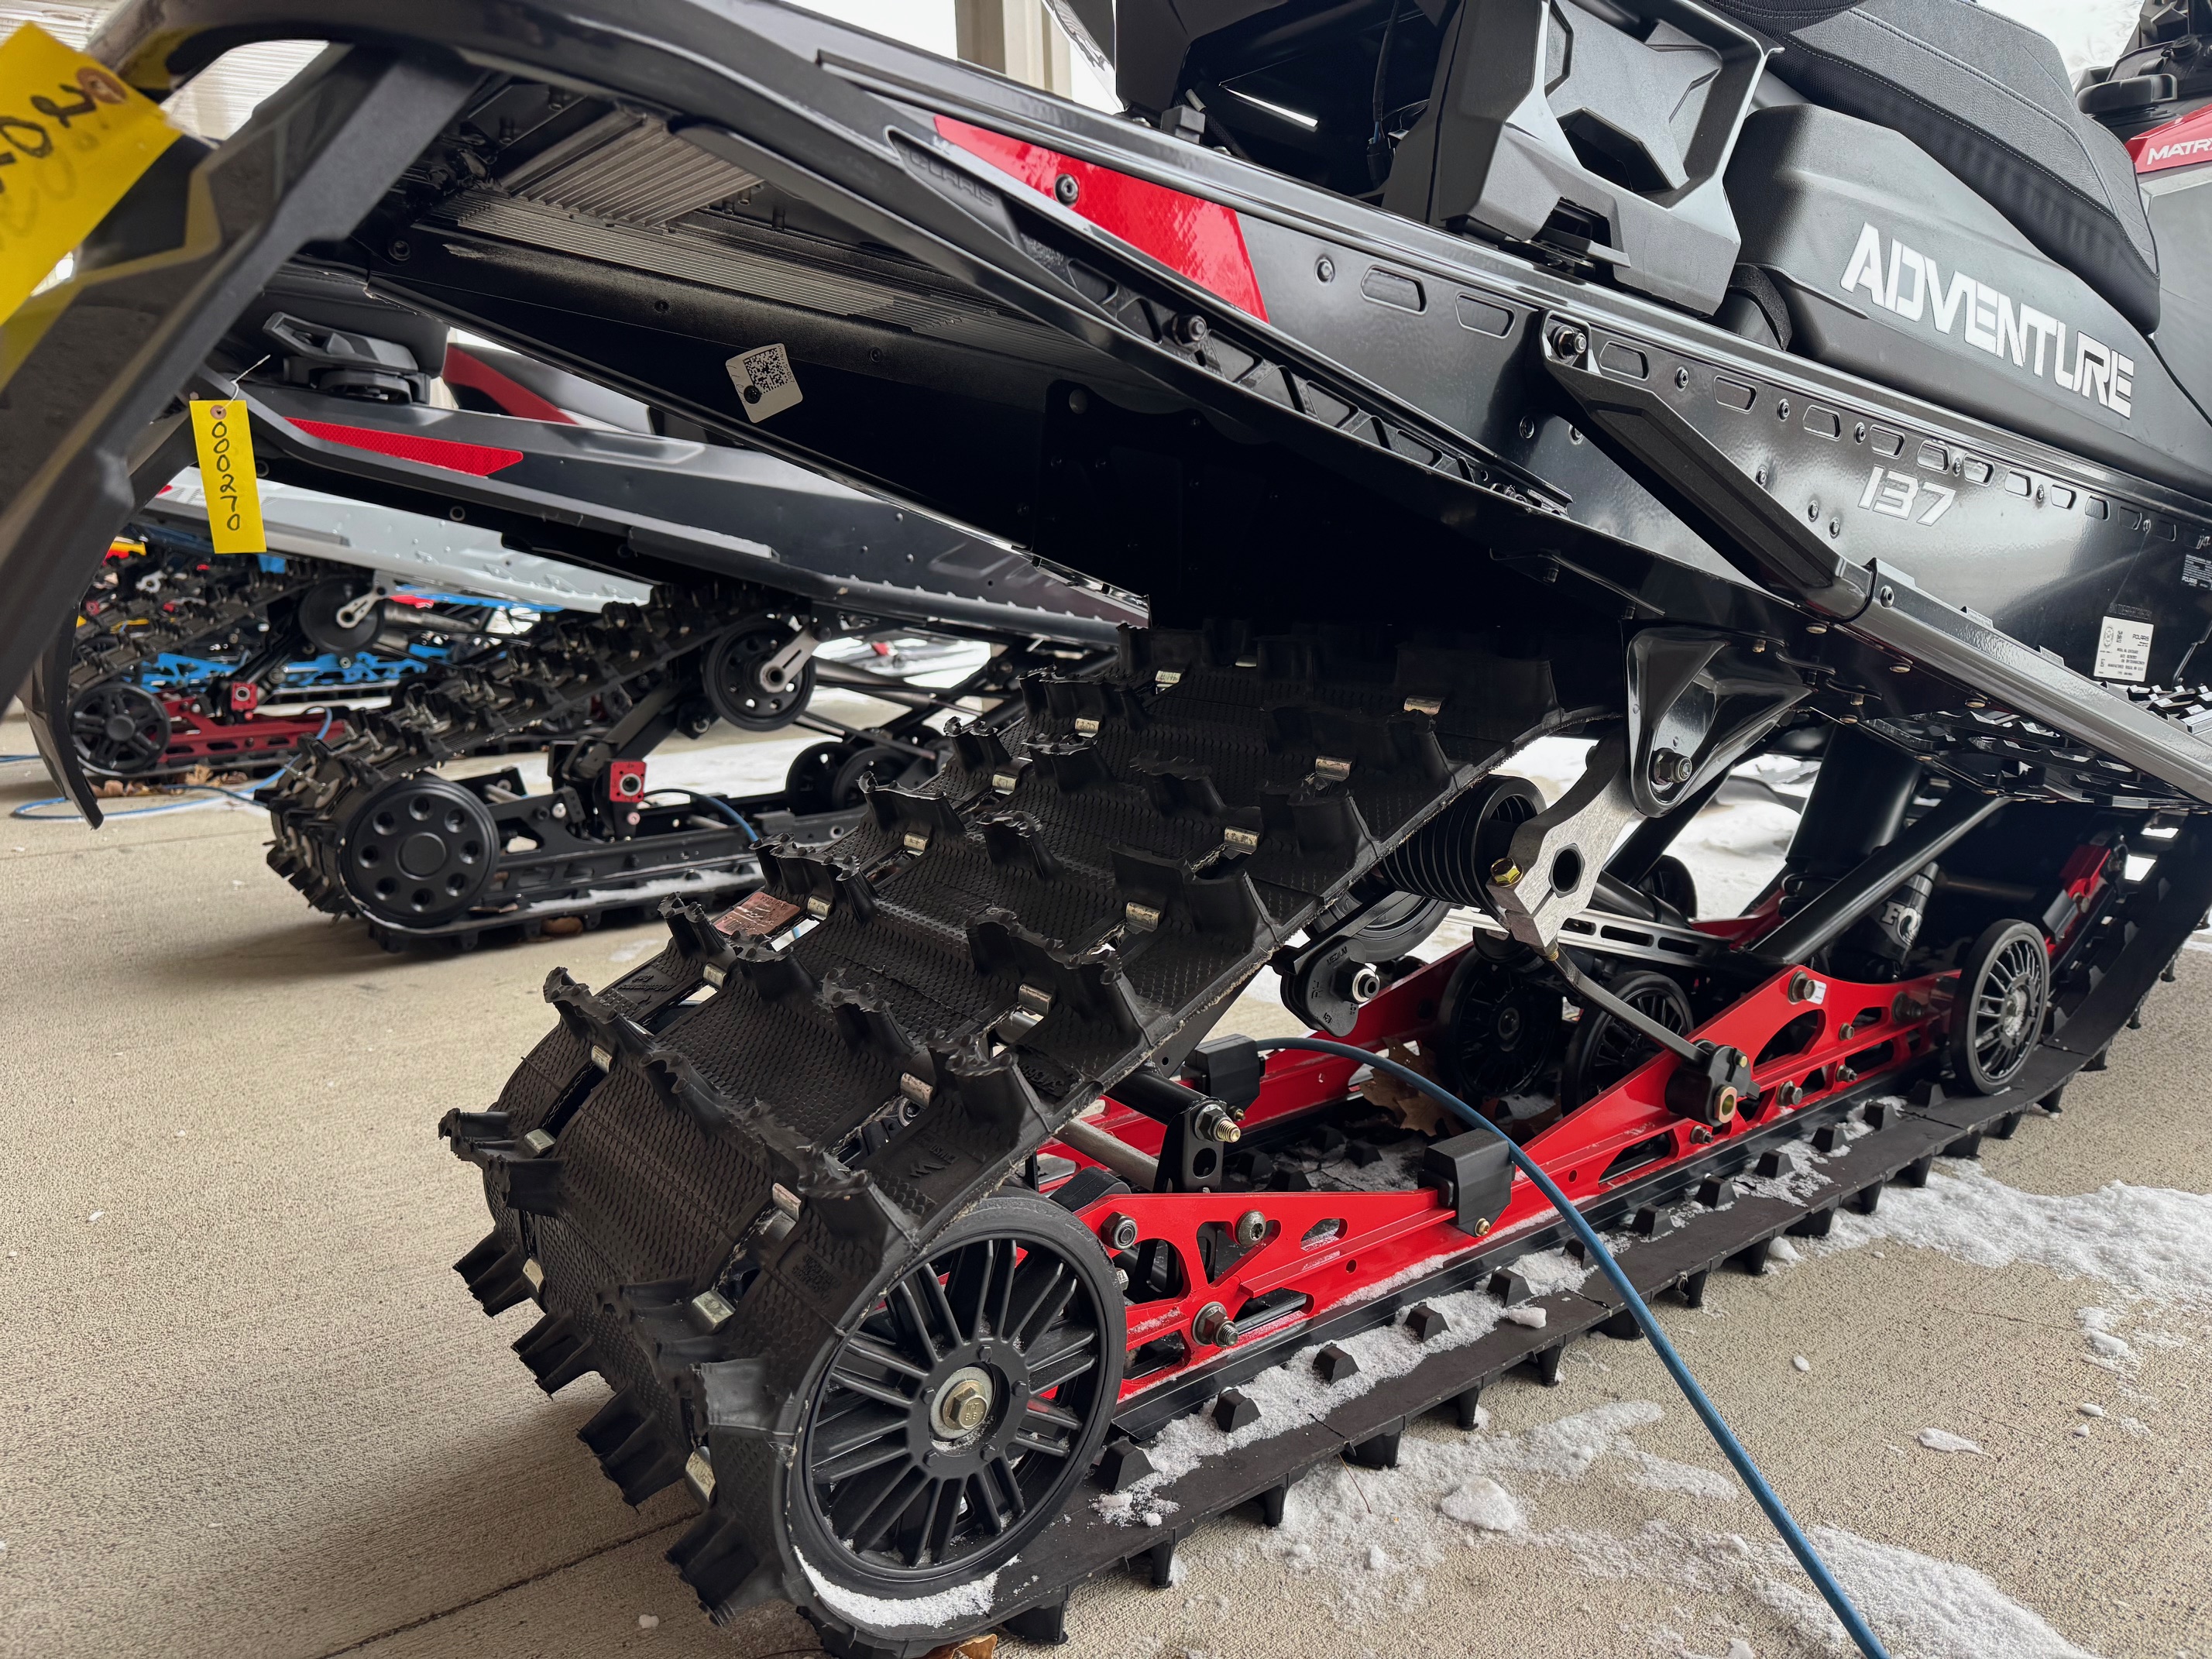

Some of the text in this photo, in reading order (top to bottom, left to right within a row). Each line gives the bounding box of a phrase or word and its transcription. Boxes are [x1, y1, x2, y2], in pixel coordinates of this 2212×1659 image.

[1840, 222, 2135, 420] ADVENTURE
[211, 421, 241, 531] 000270
[1858, 465, 1956, 527] 137
